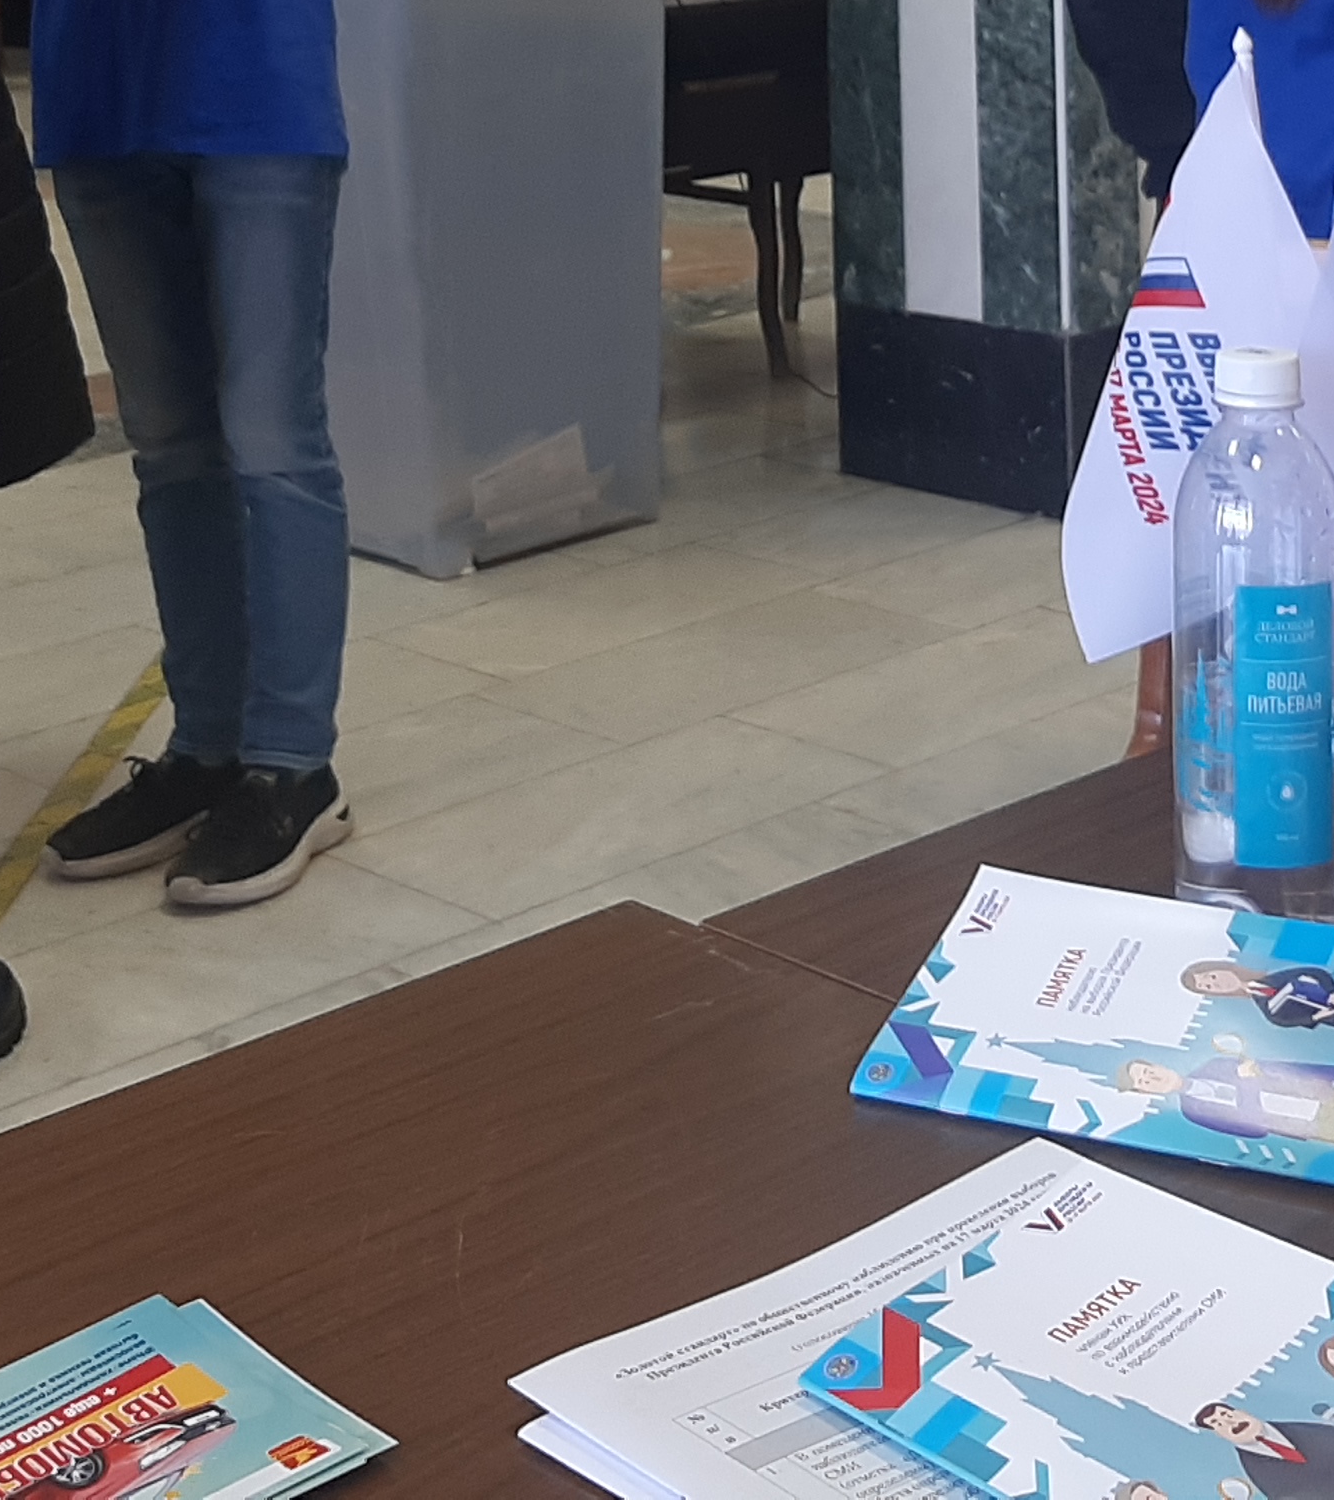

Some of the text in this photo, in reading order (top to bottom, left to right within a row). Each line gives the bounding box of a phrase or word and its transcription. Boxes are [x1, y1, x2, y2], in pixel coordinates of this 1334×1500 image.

[1124, 331, 1180, 451] РОССИИ
[1109, 393, 1146, 467] МАРТА
[1126, 471, 1170, 526] 2024
[1247, 691, 1322, 714] ПИТЬЕВАЯ
[1266, 671, 1307, 691] ВОДА
[1035, 949, 1086, 1007] ПАМЯТКА
[1046, 1277, 1142, 1344] ПАМЯТКА
[758, 1388, 810, 1411] Критер
[14, 1412, 63, 1445] 1000
